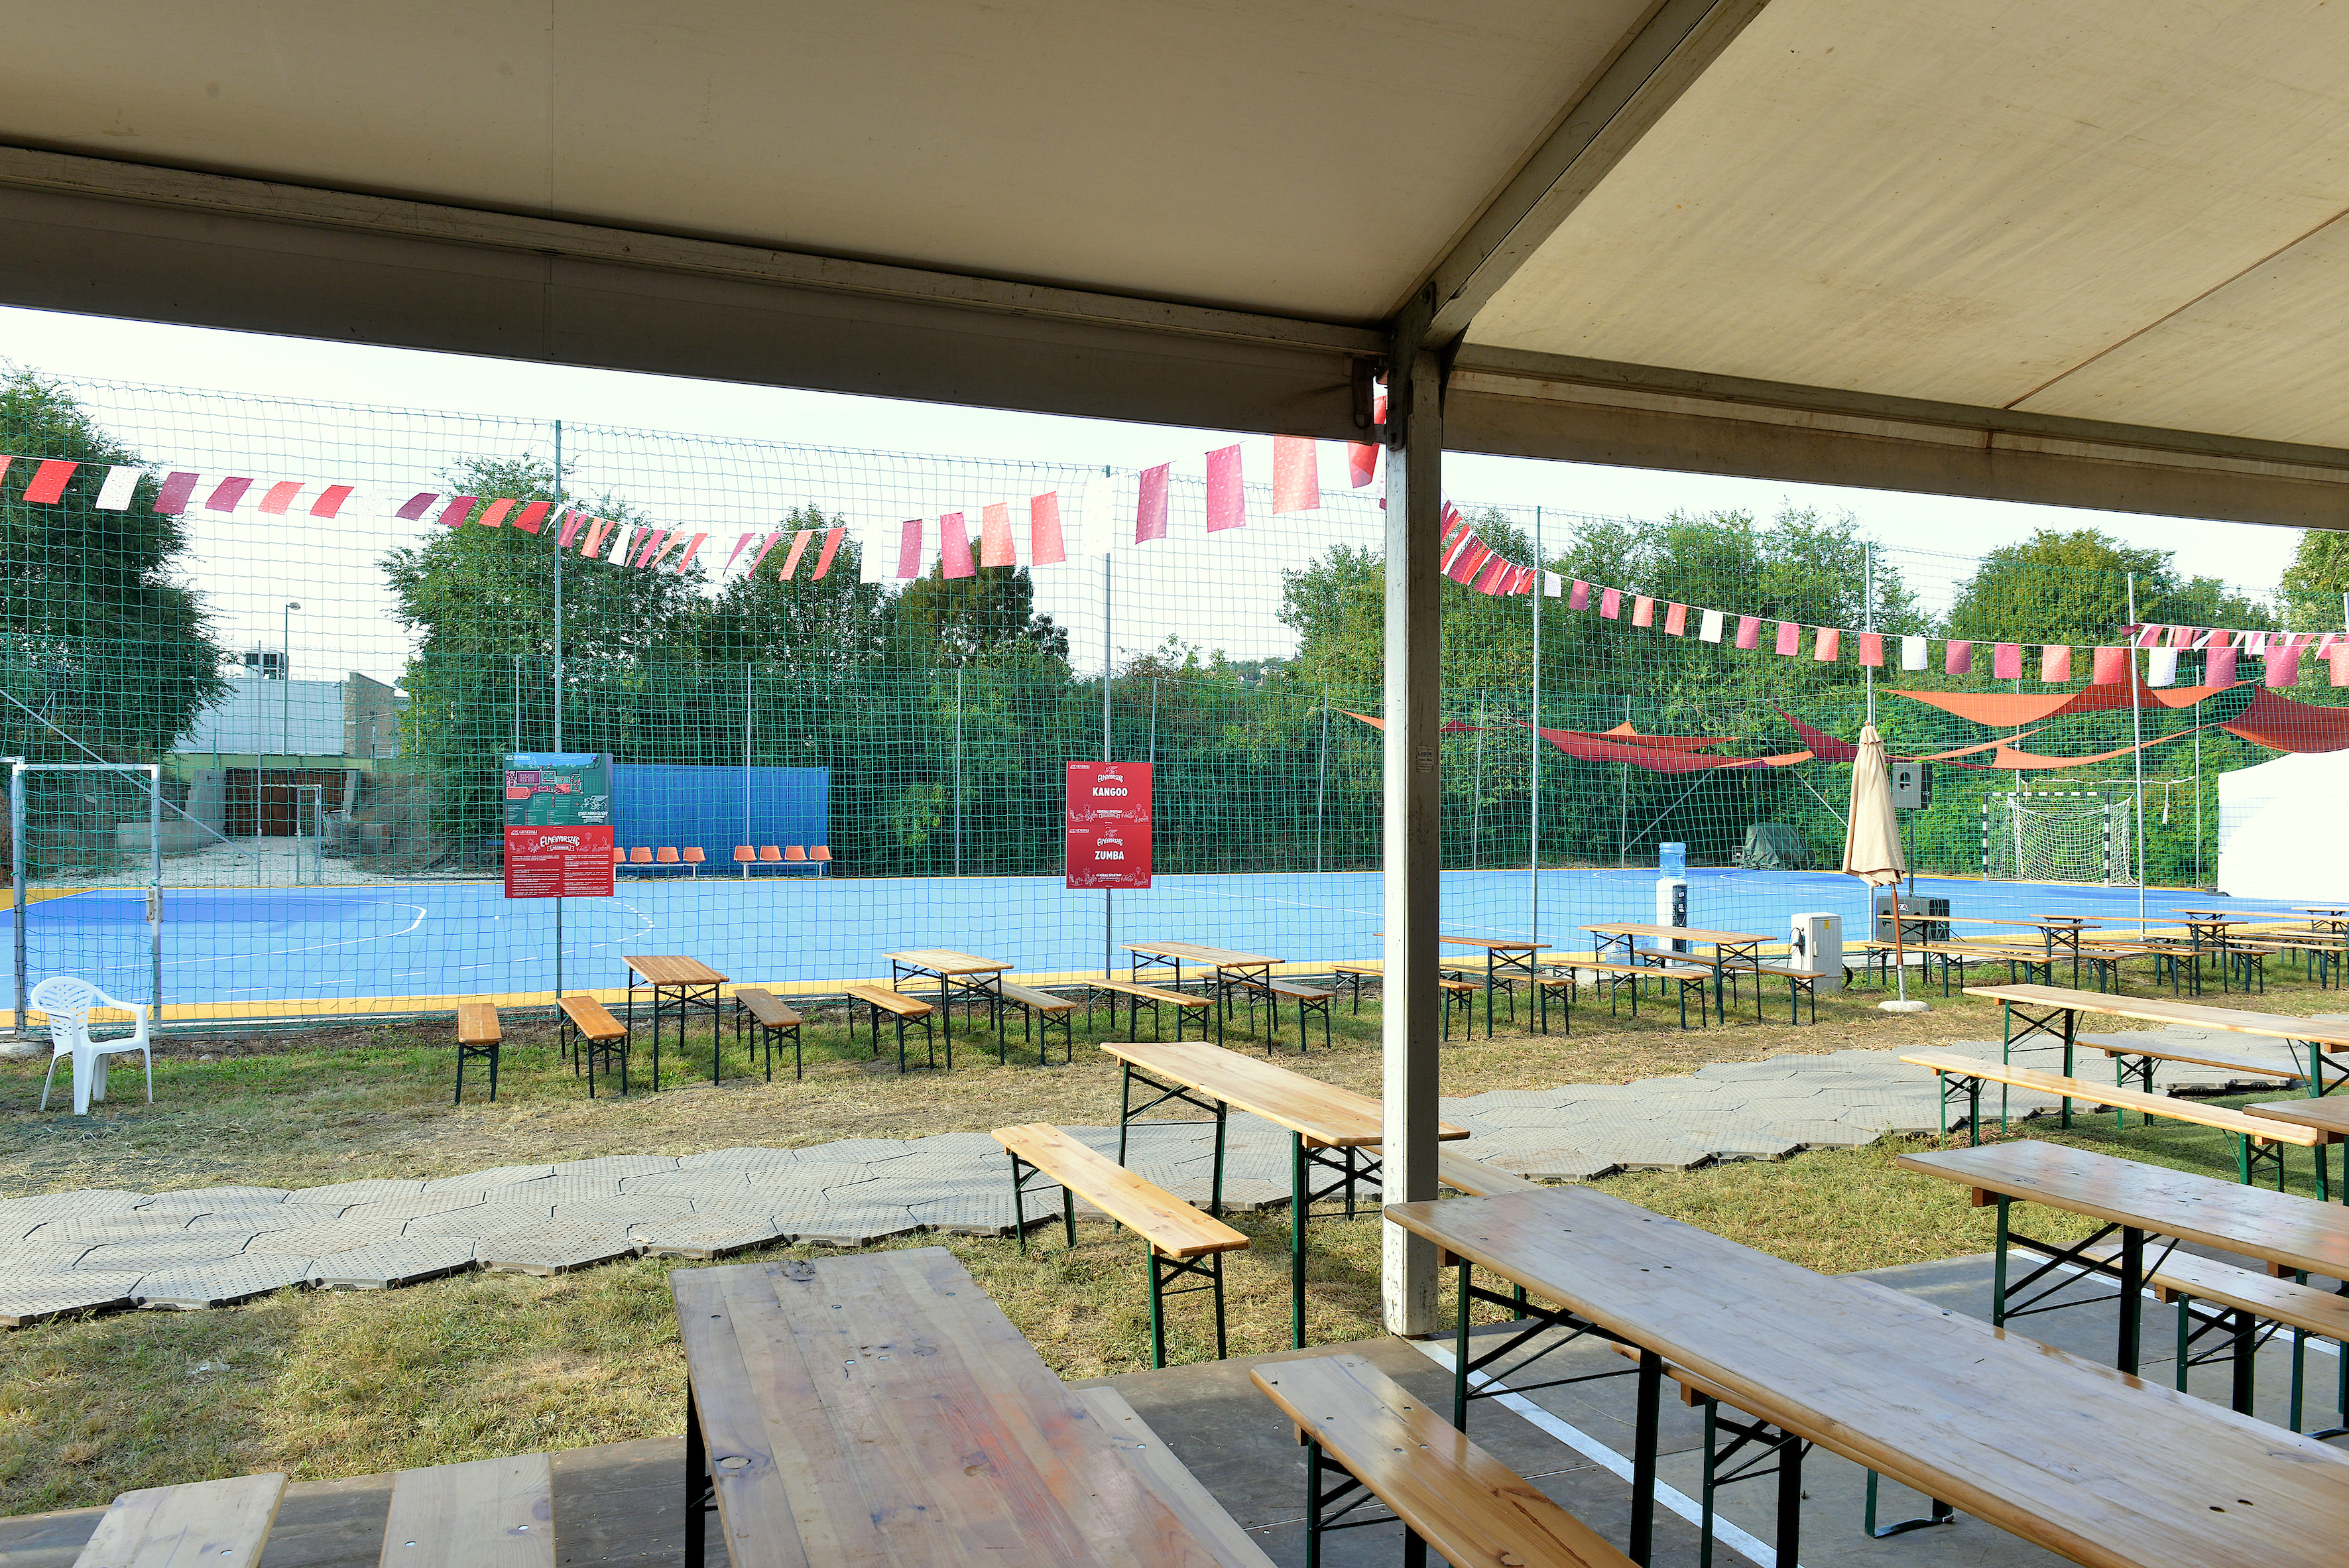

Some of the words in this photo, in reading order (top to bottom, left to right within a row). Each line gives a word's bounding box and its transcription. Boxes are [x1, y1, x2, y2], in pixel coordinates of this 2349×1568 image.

[1092, 787, 1128, 796] KANGOO
[540, 835, 581, 847] ÉLMÉNYORSZÁG
[1094, 851, 1125, 861] ZUMBA
